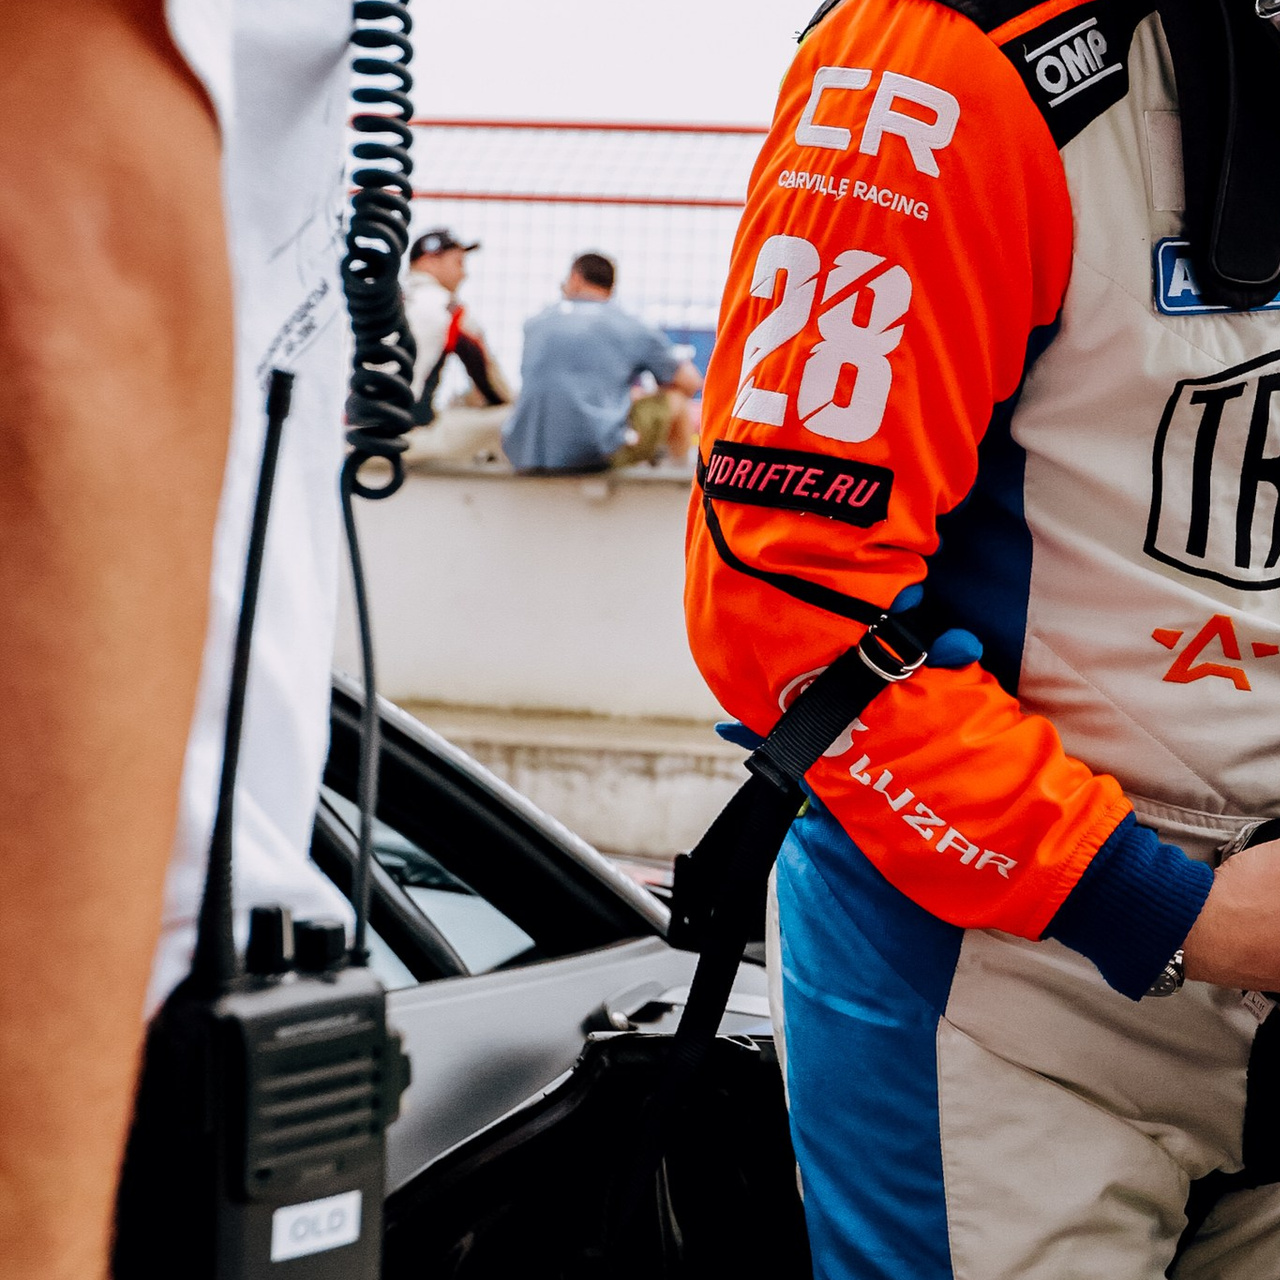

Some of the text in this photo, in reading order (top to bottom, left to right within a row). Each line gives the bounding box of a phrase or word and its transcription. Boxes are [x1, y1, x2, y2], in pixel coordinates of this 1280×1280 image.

[1035, 29, 1108, 94] OMP
[795, 66, 961, 178] CR
[777, 170, 929, 221] CARVILLE RACING
[731, 234, 914, 443] 28
[706, 454, 880, 508] VDRIFTE.RU
[849, 754, 1019, 880] LUZAR
